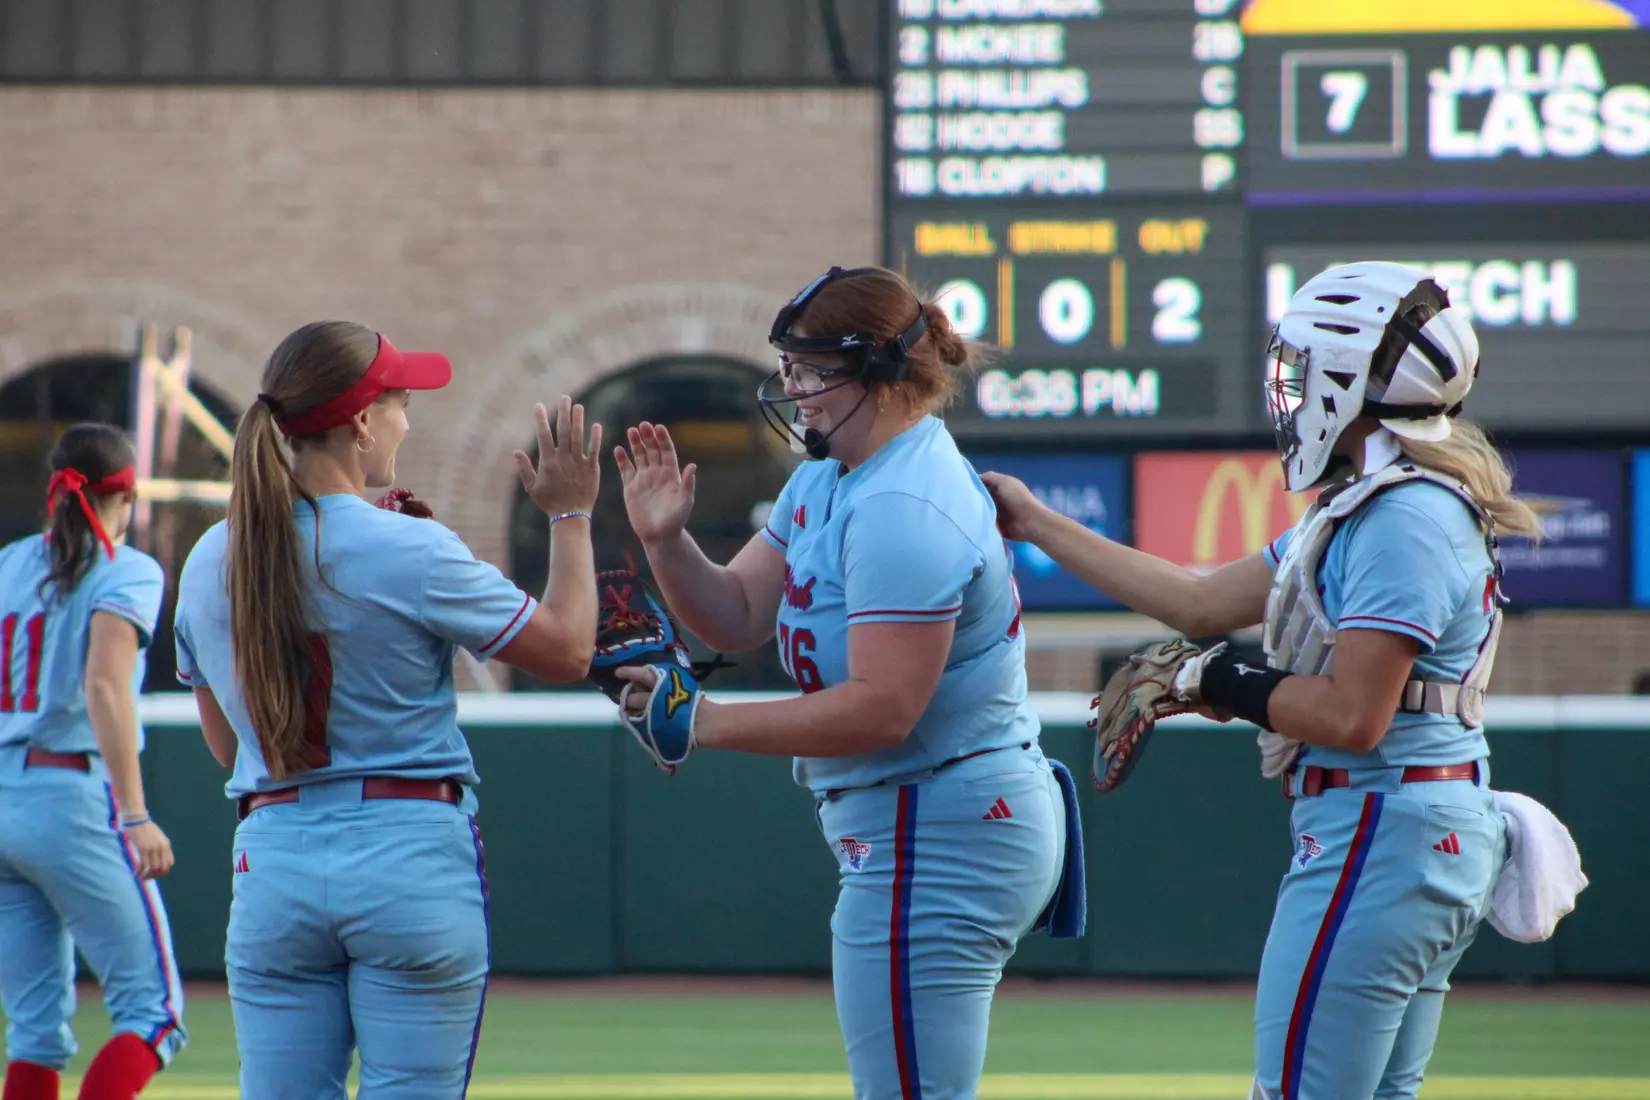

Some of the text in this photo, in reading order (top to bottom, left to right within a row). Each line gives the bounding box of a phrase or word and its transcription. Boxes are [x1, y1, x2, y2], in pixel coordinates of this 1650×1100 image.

[899, 24, 929, 65] 2
[1428, 43, 1604, 92] JALIA
[936, 69, 1088, 108] PHILLIPS
[1201, 66, 1236, 105] C
[1321, 71, 1368, 133] 7
[936, 111, 1065, 150] HODGE
[1428, 86, 1650, 158] LASS
[937, 156, 1106, 194] CLOPTON
[1201, 153, 1235, 191] P
[915, 222, 995, 256] BALL
[1009, 219, 1117, 255] STRIKE
[1139, 219, 1207, 254] OUT
[935, 278, 987, 342] 0
[1040, 277, 1094, 343] 0
[1152, 277, 1202, 342] 2
[1082, 368, 1159, 416] PM
[0, 612, 46, 713] 11
[779, 620, 825, 694] 76
